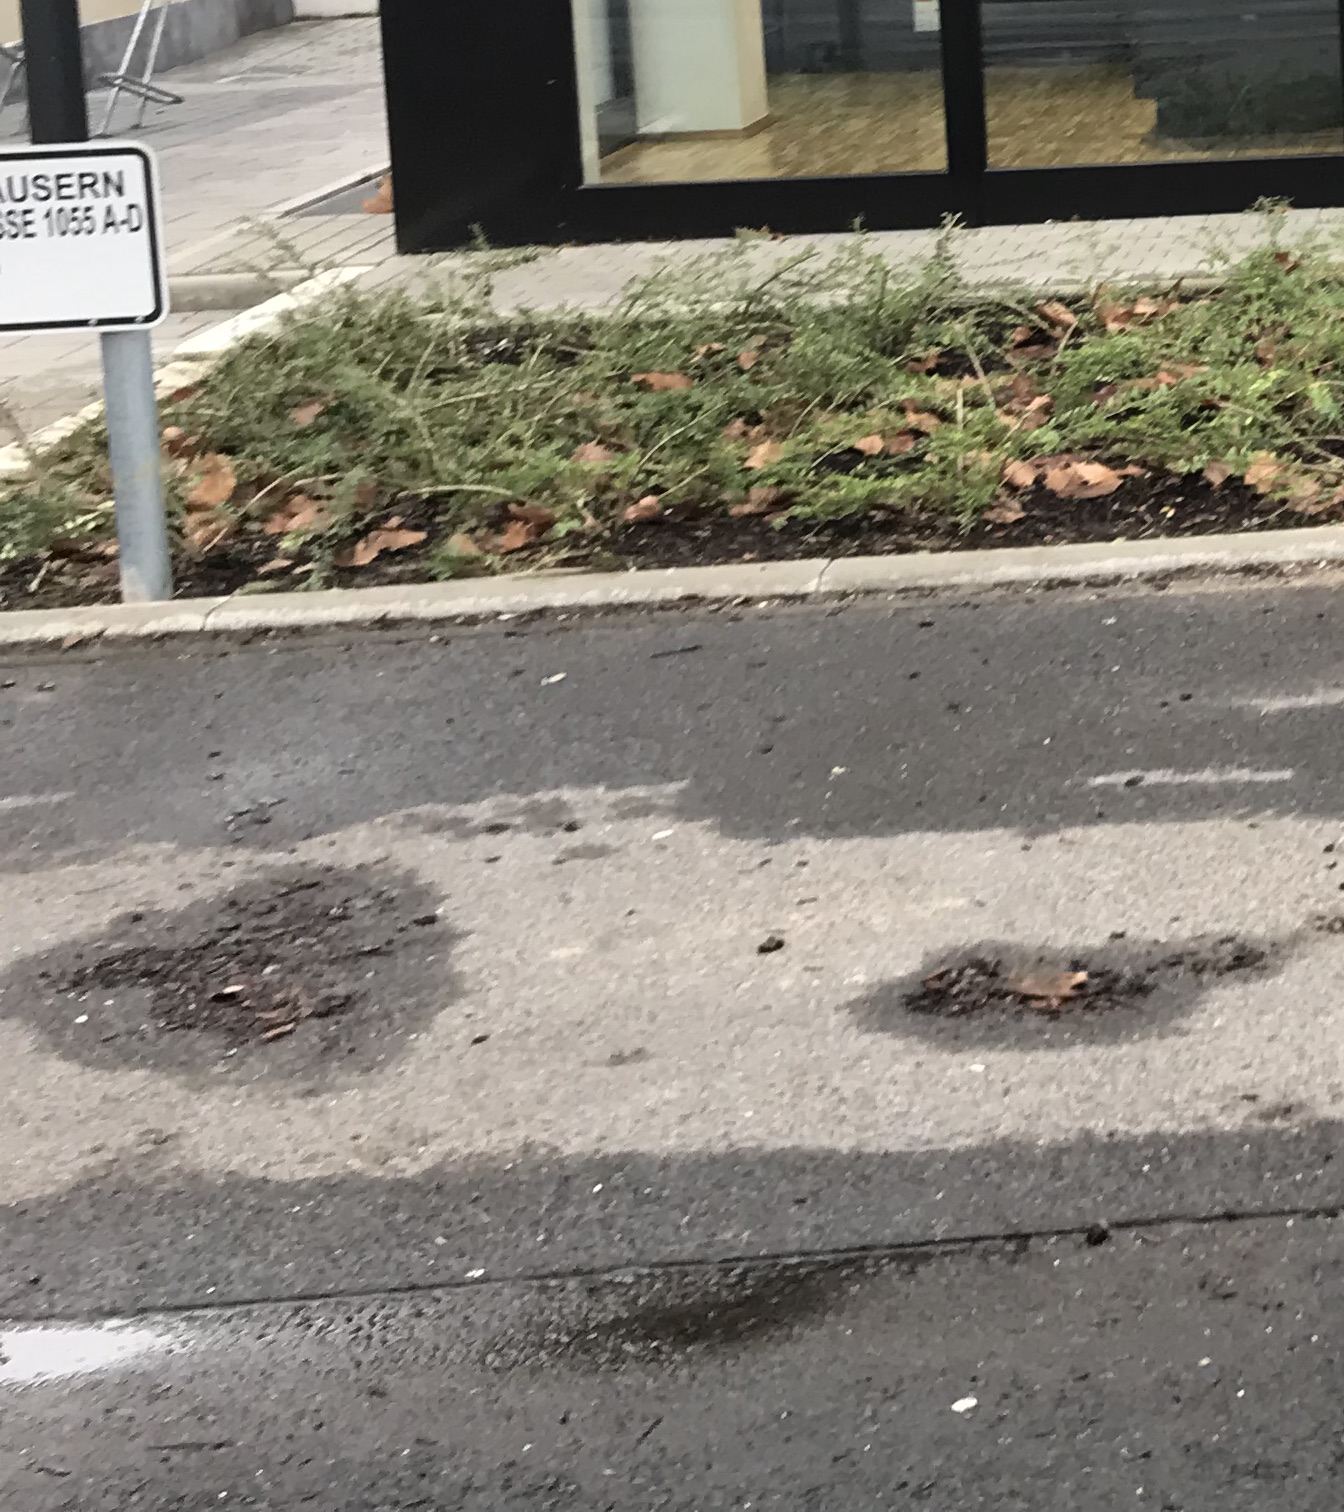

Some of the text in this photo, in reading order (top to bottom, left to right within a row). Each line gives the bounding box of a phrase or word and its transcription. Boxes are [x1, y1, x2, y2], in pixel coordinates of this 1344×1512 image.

[0, 169, 125, 204] USERN
[0, 208, 38, 240] SE
[101, 202, 143, 234] A-D
